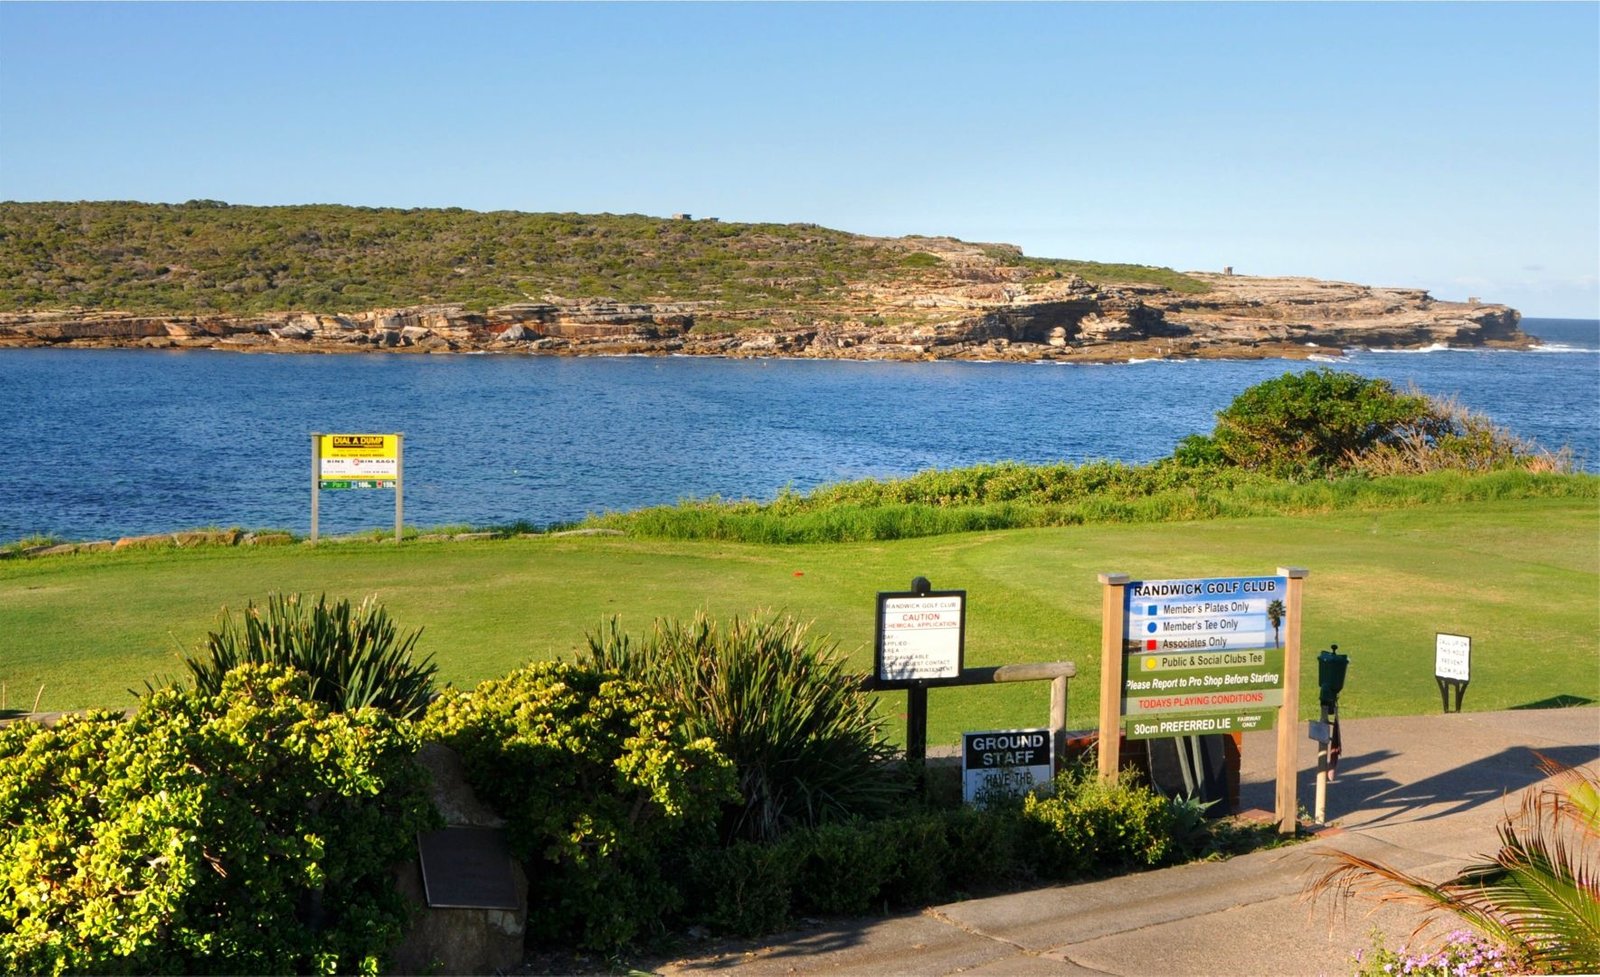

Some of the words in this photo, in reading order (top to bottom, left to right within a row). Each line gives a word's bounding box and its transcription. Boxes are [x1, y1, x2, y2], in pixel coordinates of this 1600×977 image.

[1134, 584, 1202, 597] RANDWICK
[1207, 582, 1239, 594] GOLF
[1243, 581, 1275, 593] CLUB
[1164, 604, 1202, 615] Member's
[1204, 603, 1230, 613] Plates
[1231, 601, 1249, 613] Only
[1163, 621, 1202, 632] Member's
[1204, 620, 1218, 630] Tee
[1220, 619, 1238, 630] Only
[1163, 638, 1207, 649] Associates
[1209, 636, 1227, 648] Only
[1162, 656, 1187, 666] Public
[1189, 656, 1195, 665] &
[1198, 655, 1222, 666] Social
[1224, 654, 1247, 664] Clubs
[1249, 653, 1263, 663] Tee
[1127, 679, 1150, 690] Please
[1152, 678, 1178, 690] Report
[1179, 678, 1187, 688] to
[1189, 676, 1202, 687] Pro
[1204, 675, 1224, 687] Shop
[1225, 673, 1249, 685] Before
[1250, 672, 1278, 685] Starting
[1139, 698, 1172, 709] TODAYS
[1174, 696, 1210, 707] PLAYING
[1212, 693, 1263, 705] CONDITIONS
[1134, 723, 1158, 734] 30cm
[1160, 719, 1215, 732] PREFERRED
[1217, 718, 1231, 729] LIE
[972, 735, 1044, 751] GROUND
[983, 750, 1034, 765] STAFF
